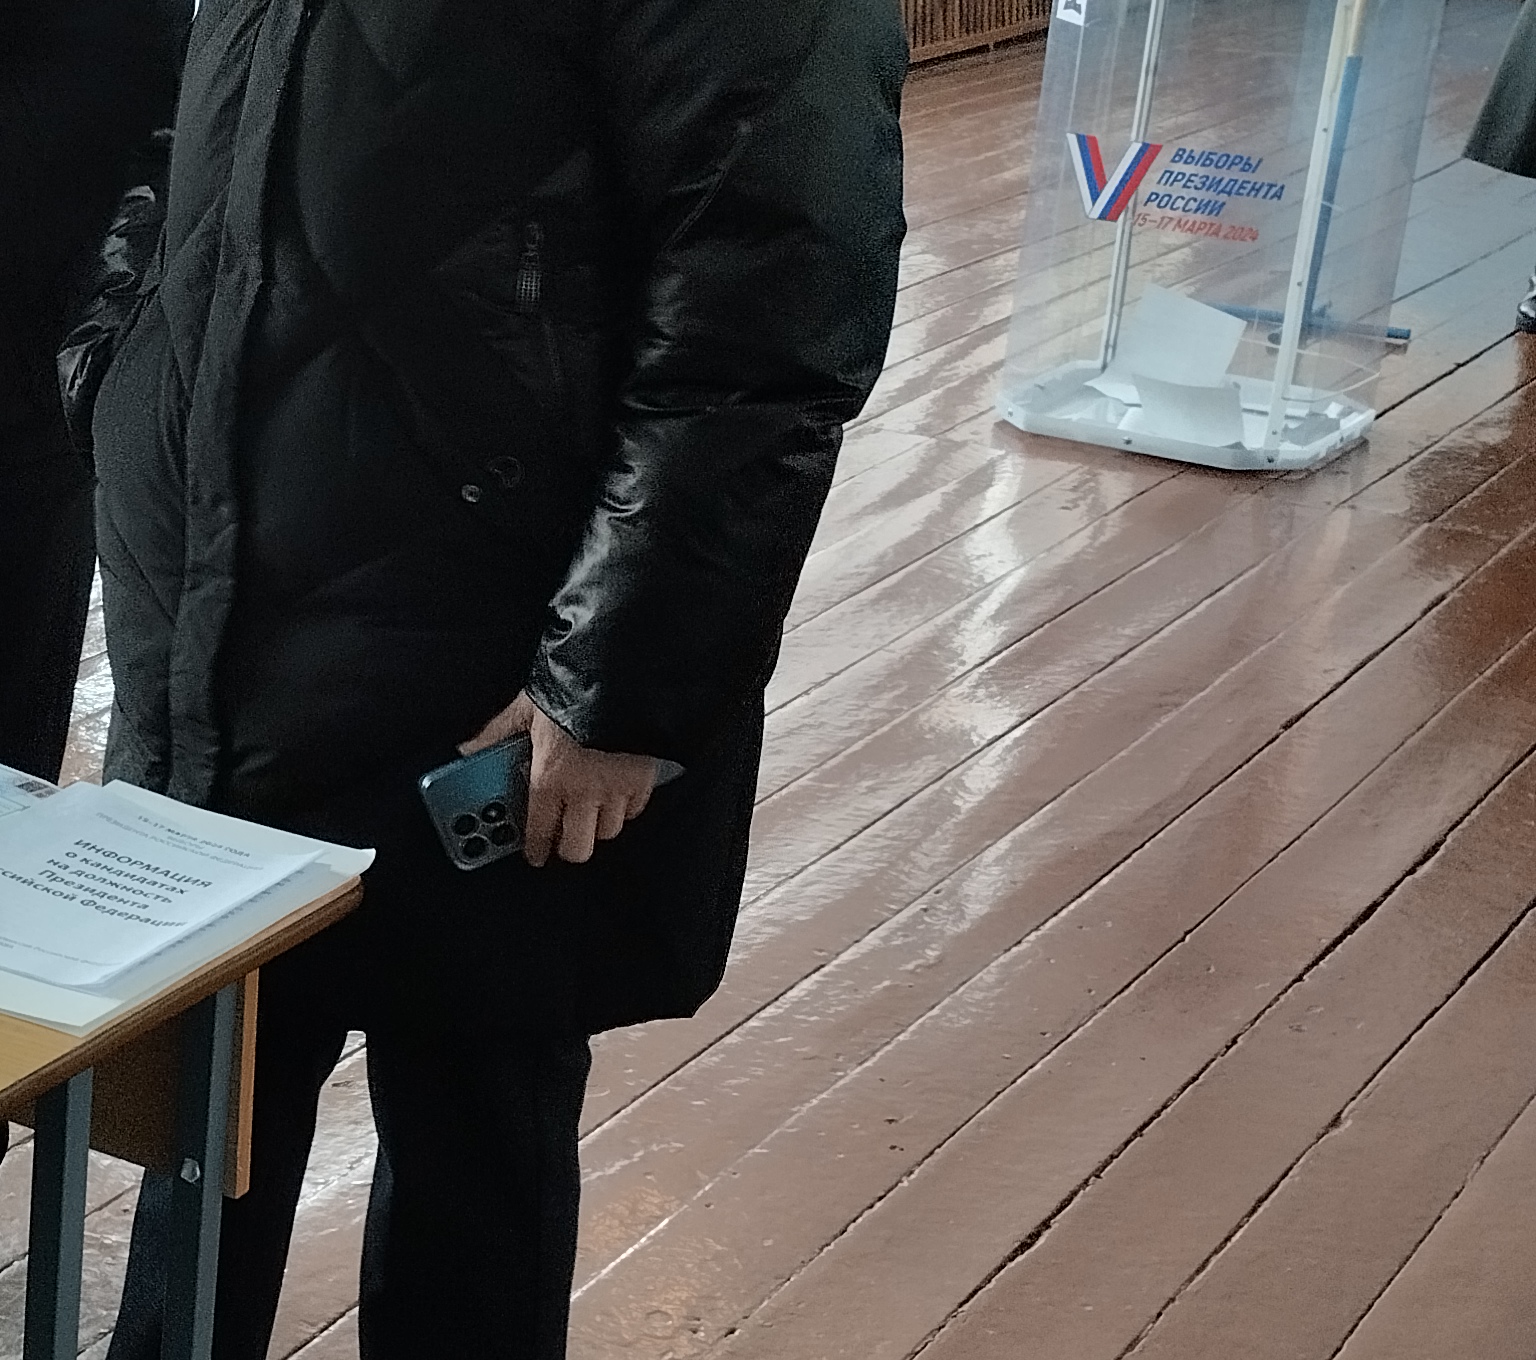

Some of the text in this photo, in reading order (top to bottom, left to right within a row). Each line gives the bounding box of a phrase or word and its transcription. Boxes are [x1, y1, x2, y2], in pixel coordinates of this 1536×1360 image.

[1170, 147, 1263, 174] ВЫБОРЫ
[1156, 169, 1286, 201] ПРЕЗИДЕНТА
[1143, 191, 1226, 217] РОССИИ
[1172, 217, 1223, 238] МАРТА
[1222, 225, 1259, 242] 2024
[73, 839, 213, 888] ИНФОРМАЦИЯ
[79, 857, 189, 895] кандидатах
[38, 869, 149, 909] Президента
[46, 859, 172, 903] на должность
[80, 899, 187, 927] Федерации
